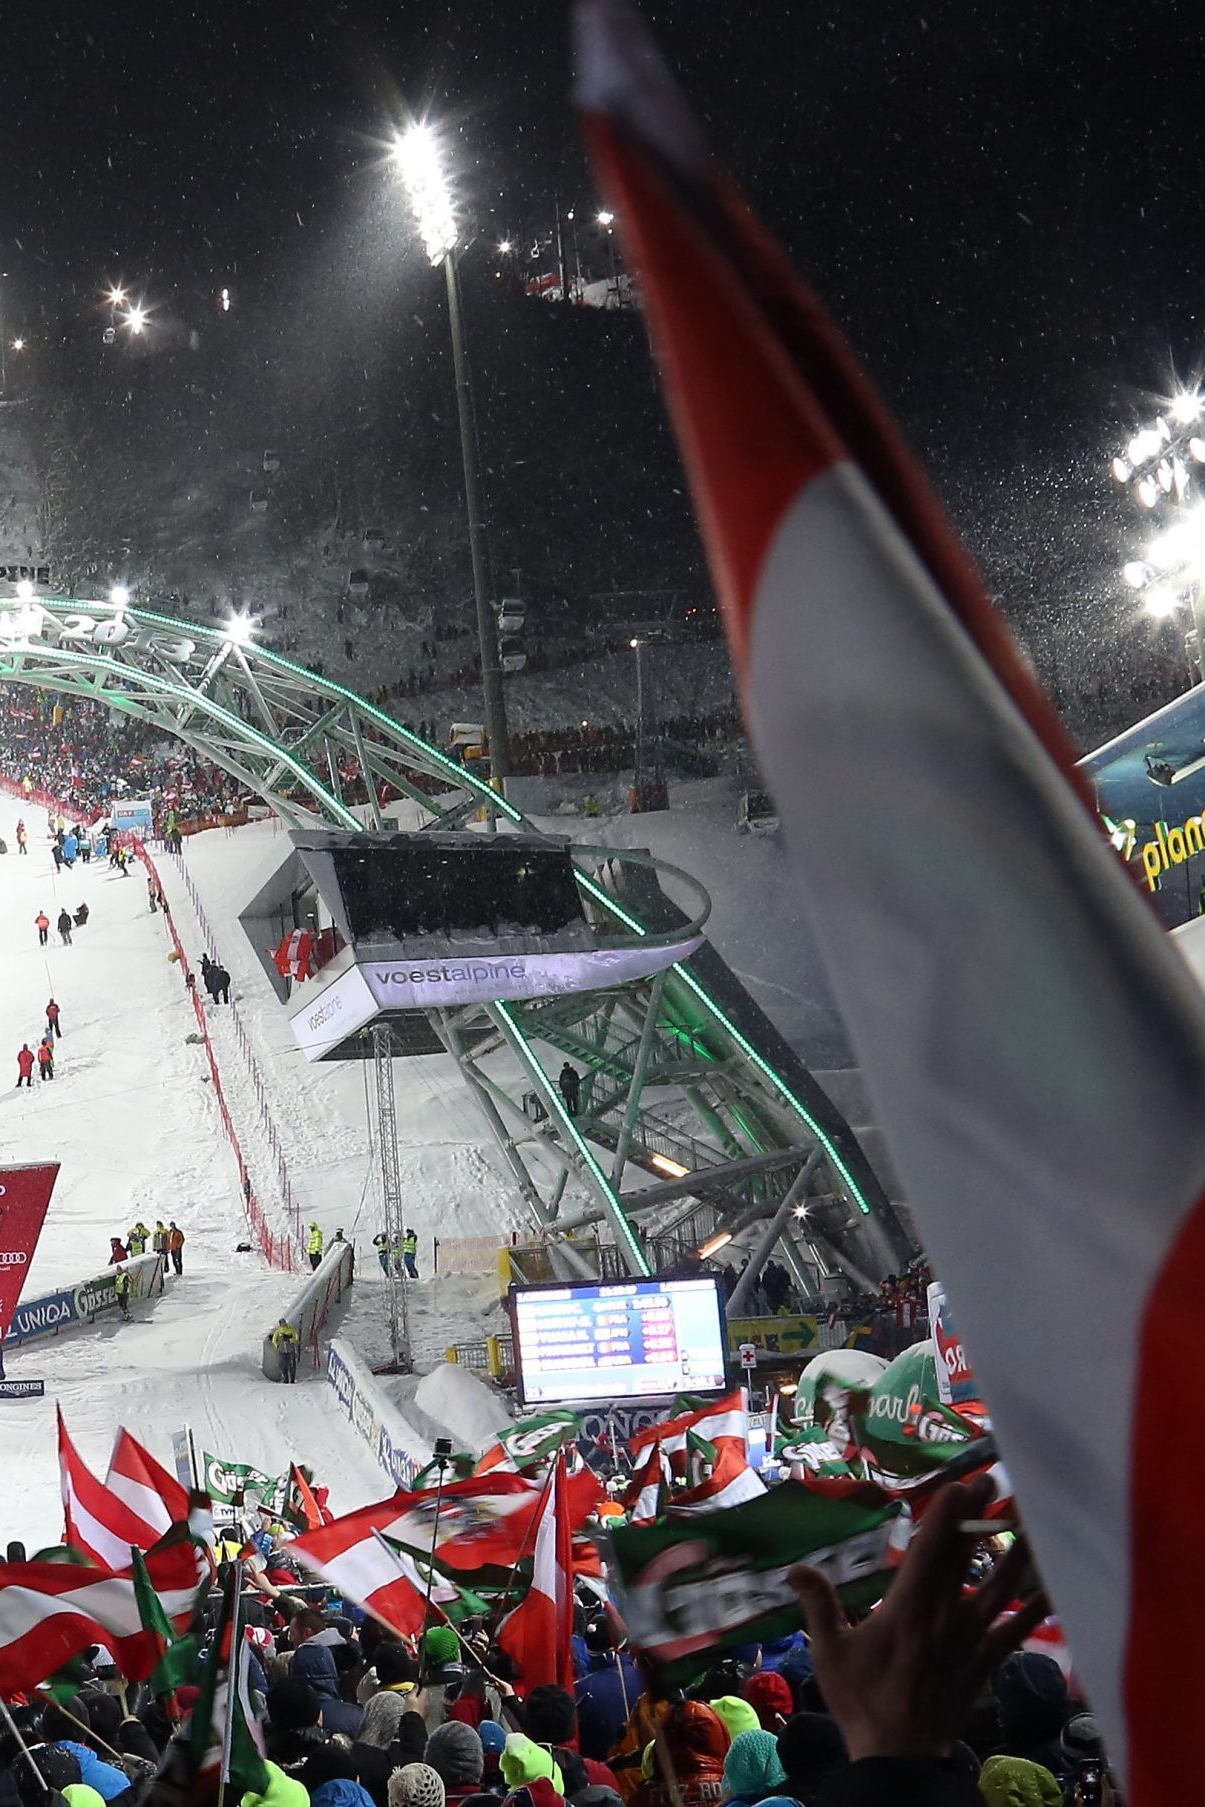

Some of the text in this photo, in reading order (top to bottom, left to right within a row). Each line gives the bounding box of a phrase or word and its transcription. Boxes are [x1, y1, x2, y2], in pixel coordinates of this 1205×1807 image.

[60, 613, 196, 663] 2013
[375, 963, 527, 986] voestalpine
[307, 993, 343, 1032] voestalpine
[17, 1300, 71, 1333] UNIQA
[73, 1286, 119, 1319] Gösse
